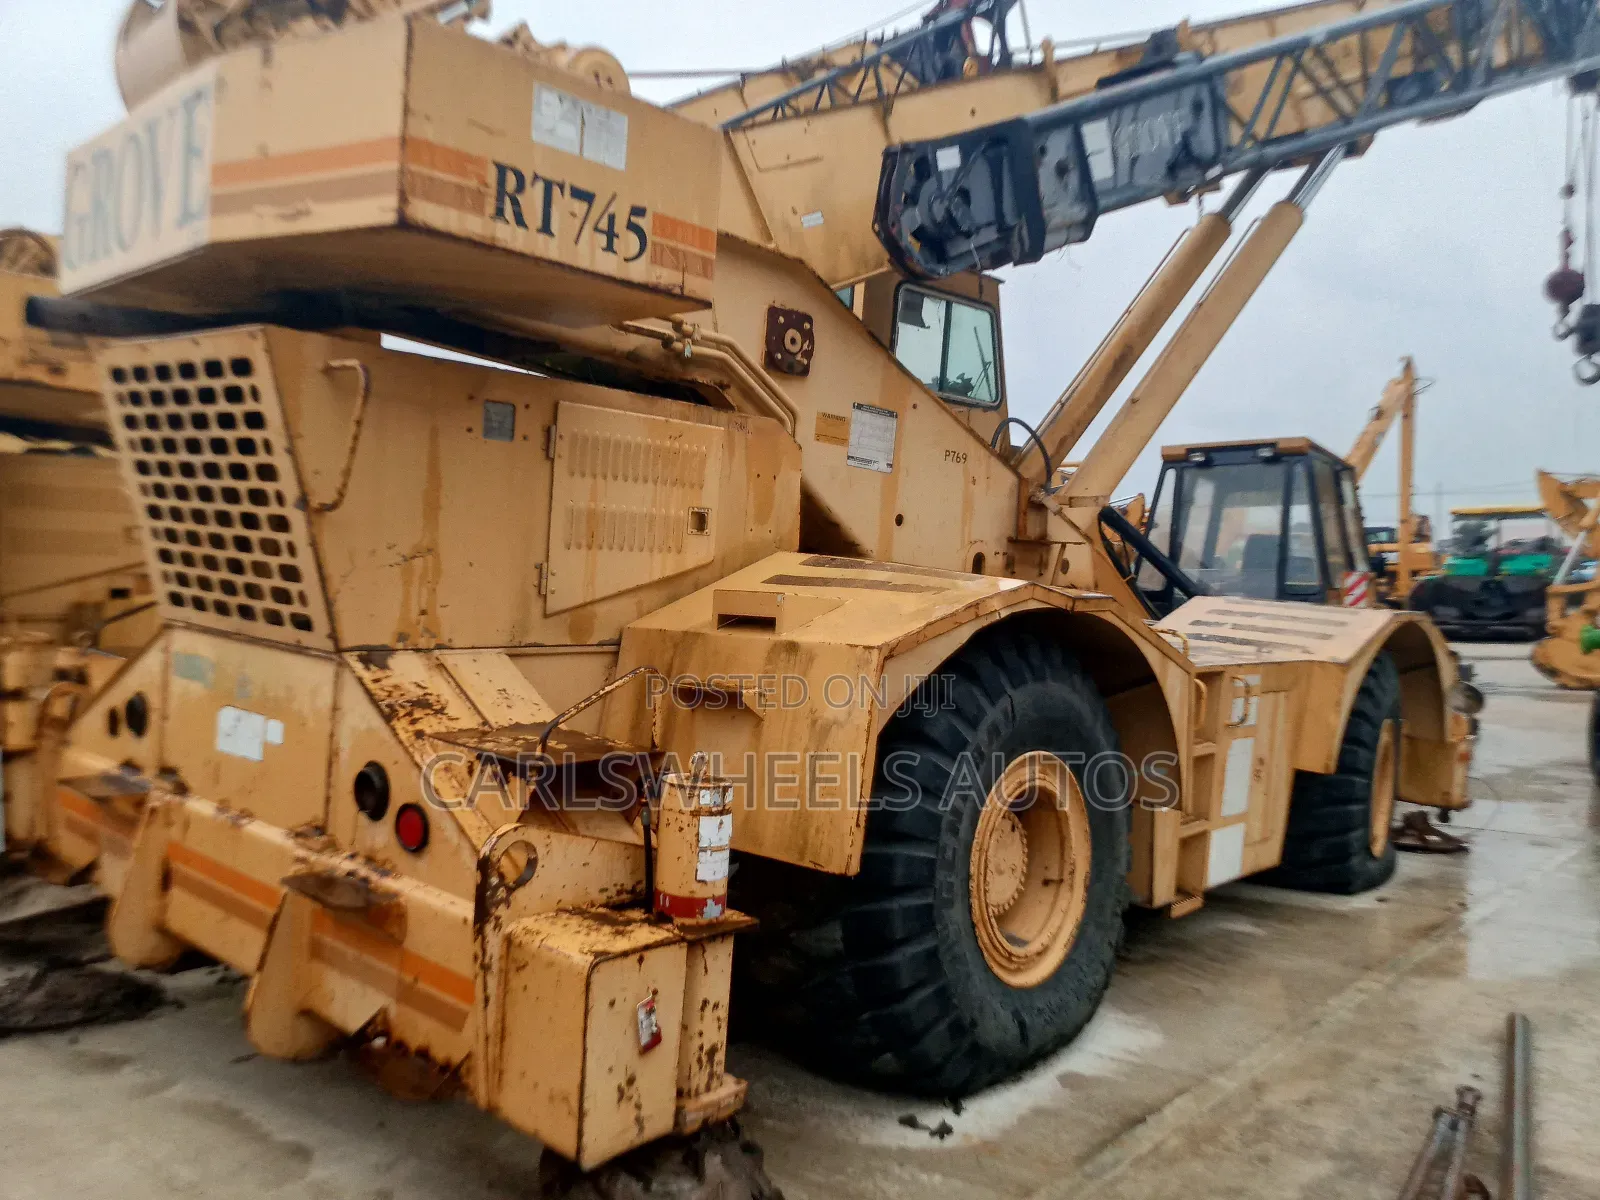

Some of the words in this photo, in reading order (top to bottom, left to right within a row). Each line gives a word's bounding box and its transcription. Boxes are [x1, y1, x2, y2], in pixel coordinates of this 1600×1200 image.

[65, 86, 211, 272] GROVE
[490, 159, 648, 263] RT745
[944, 449, 967, 464] P769
